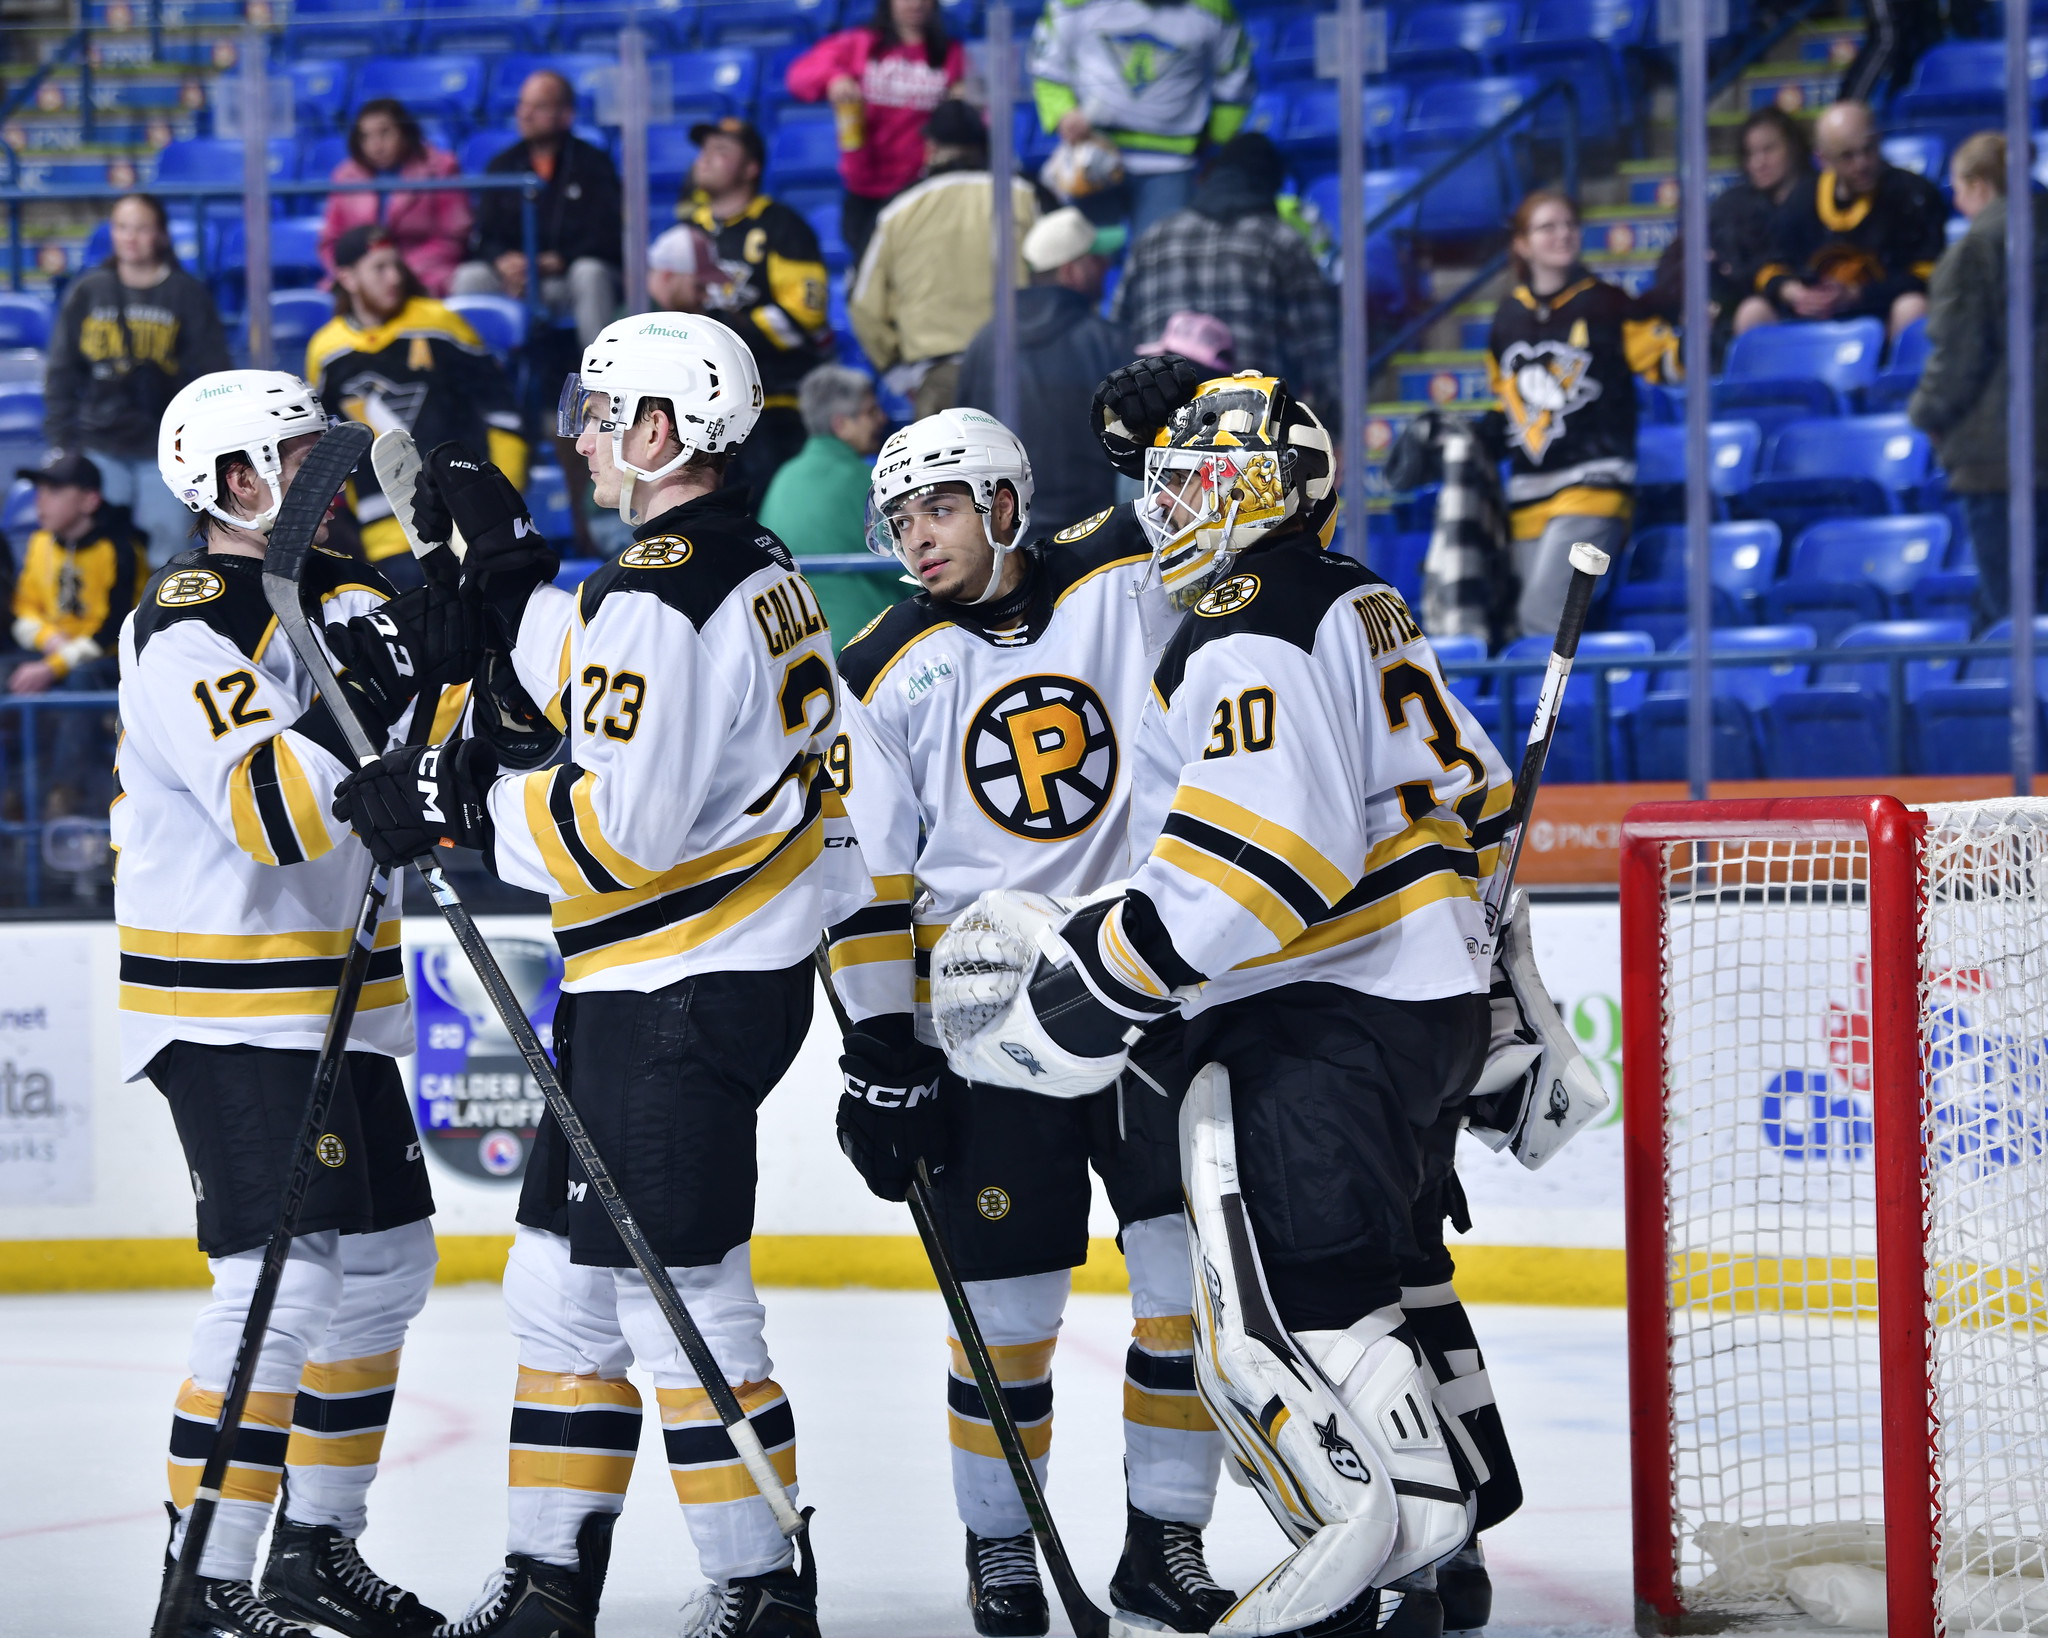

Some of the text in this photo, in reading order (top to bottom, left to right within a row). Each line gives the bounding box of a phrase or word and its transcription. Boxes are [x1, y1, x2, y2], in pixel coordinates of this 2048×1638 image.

[639, 323, 688, 340] Amica
[962, 413, 999, 426] Amica
[879, 457, 912, 479] CCM
[907, 660, 953, 701] Amica
[193, 668, 274, 742] 12
[580, 663, 648, 744] 23
[1202, 684, 1277, 761] 30
[416, 745, 448, 824] CM
[420, 1072, 521, 1100] CALDER
[844, 1072, 940, 1109] CCM
[429, 1100, 546, 1128] PLAYOFF
[520, 1036, 618, 1199] JETSPEED
[1147, 1581, 1183, 1613] BAUER
